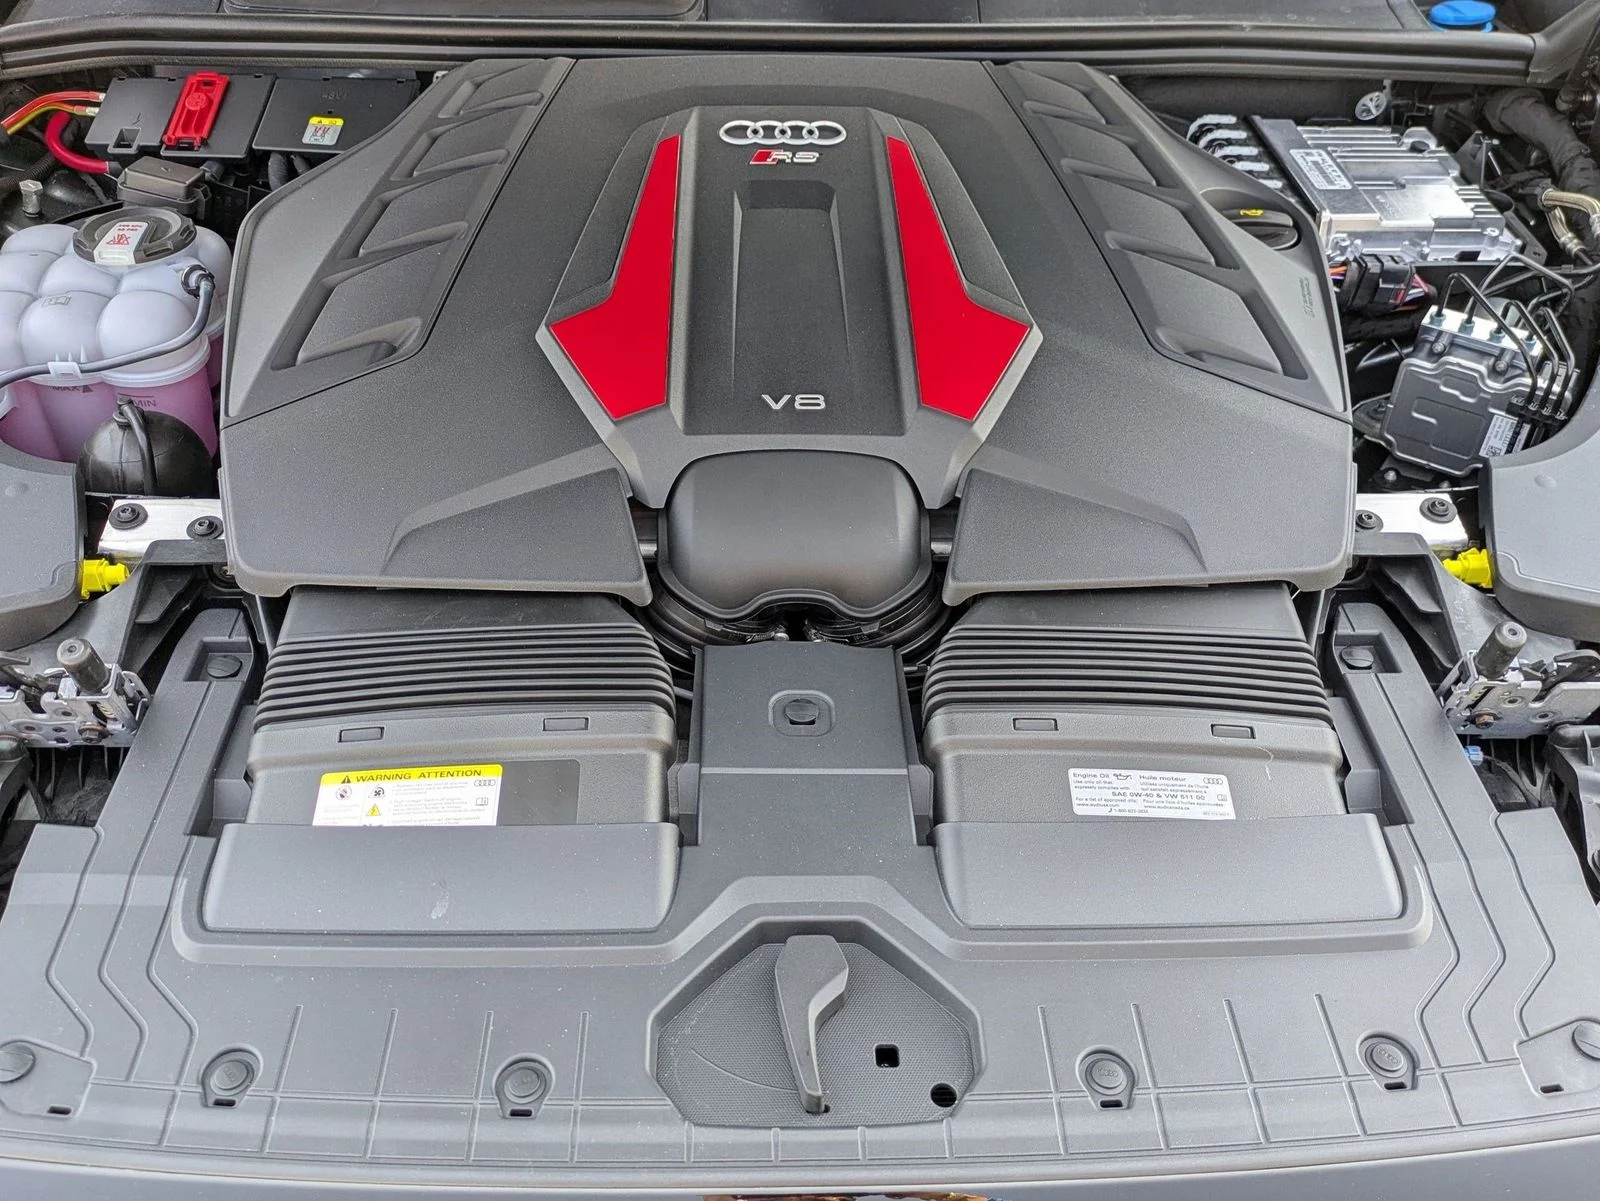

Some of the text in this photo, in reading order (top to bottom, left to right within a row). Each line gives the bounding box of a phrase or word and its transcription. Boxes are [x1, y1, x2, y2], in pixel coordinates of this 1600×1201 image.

[750, 149, 820, 165] RS
[761, 393, 826, 410] V8
[356, 769, 482, 782] WARNING ATTENTION
